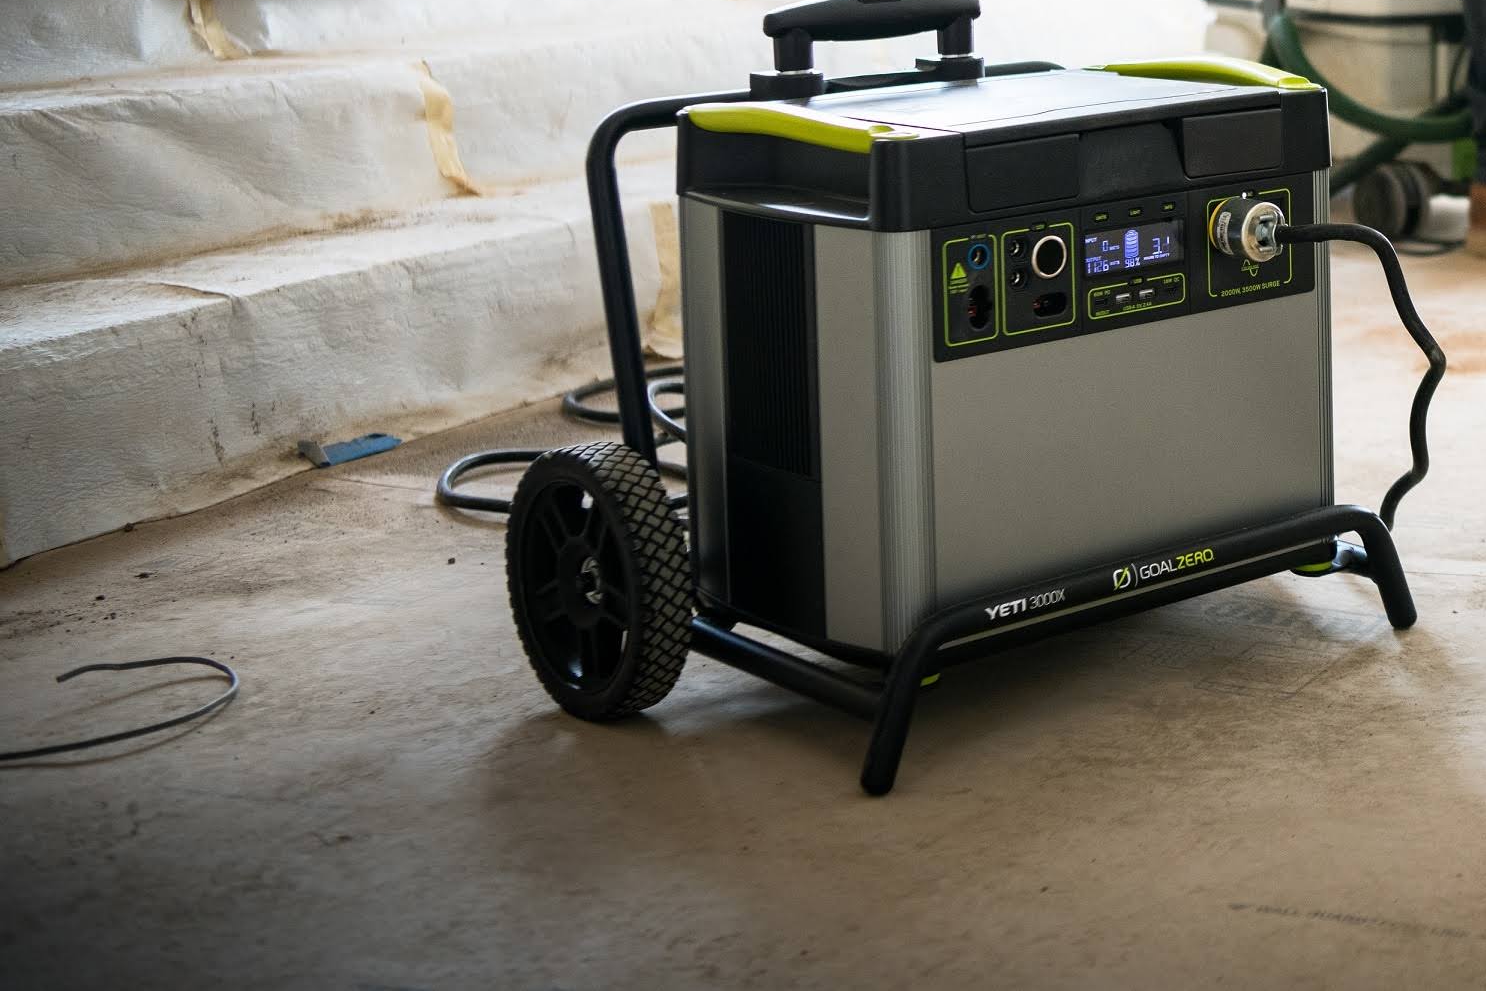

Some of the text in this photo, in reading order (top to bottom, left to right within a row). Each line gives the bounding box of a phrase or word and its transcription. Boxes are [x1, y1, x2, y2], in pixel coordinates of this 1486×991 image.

[1124, 258, 1140, 268] 98%
[1242, 284, 1261, 294] 3500W
[1262, 280, 1280, 289] SURGE
[984, 588, 1066, 620] YETI 3000X
